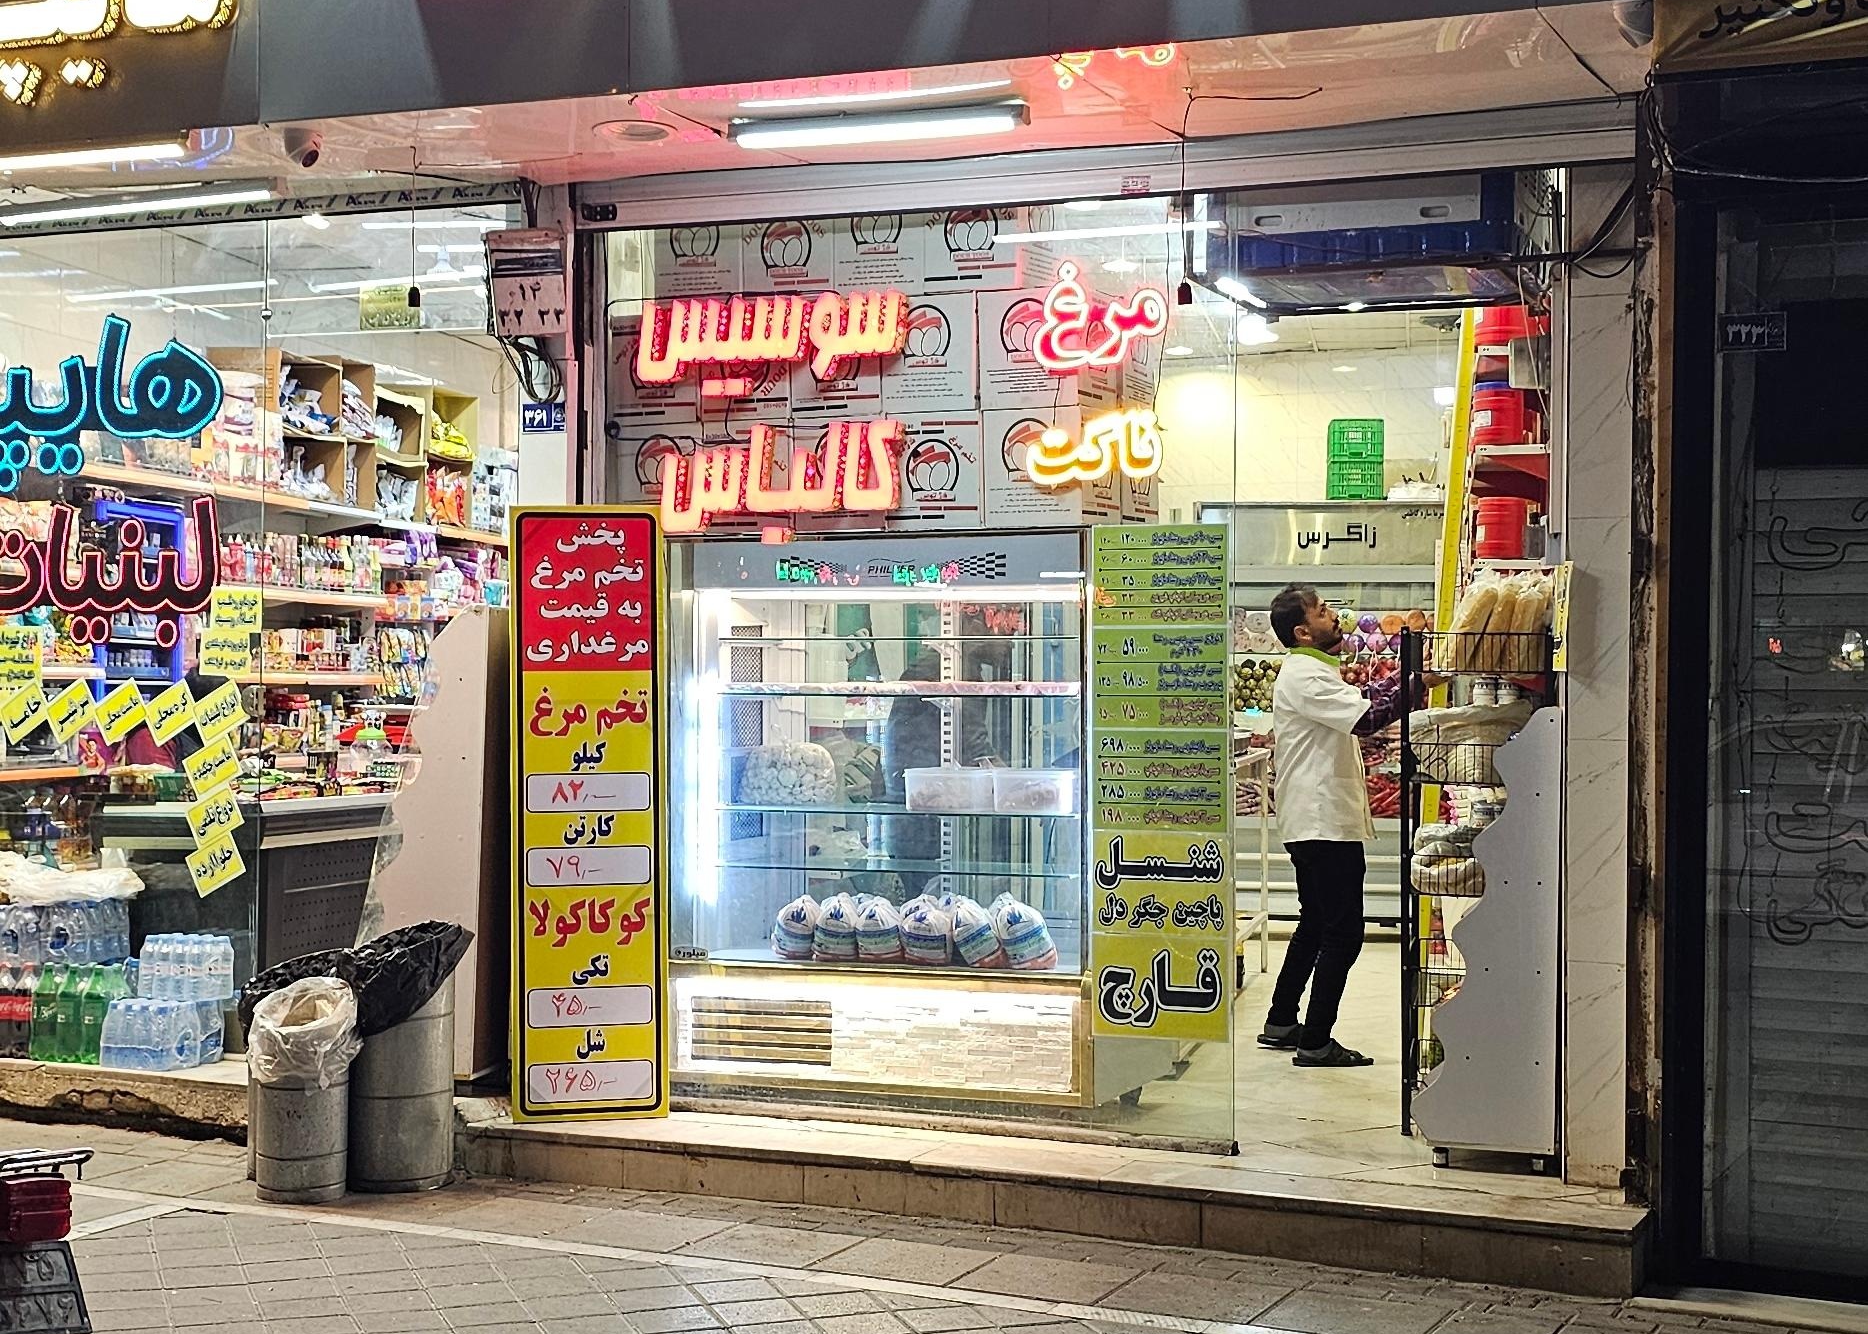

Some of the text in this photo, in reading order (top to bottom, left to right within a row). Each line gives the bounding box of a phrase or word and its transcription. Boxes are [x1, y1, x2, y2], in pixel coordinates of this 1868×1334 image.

[1033, 261, 1169, 370] مرغ
[637, 287, 909, 399] سوسیس
[524, 409, 547, 427] ۳۶۱
[661, 421, 905, 545] کالباس
[556, 522, 626, 554] پخش
[1297, 523, 1377, 550] زاگرس
[530, 555, 644, 589] تخم مرغ
[539, 592, 643, 624] به قیمت
[526, 630, 649, 662] مرغداری
[530, 686, 648, 736] تخم مرغ
[571, 741, 606, 771] کیلو
[563, 815, 614, 845] کارتن
[1095, 835, 1224, 889] شنسل
[528, 898, 650, 947] کوکاکولا
[1099, 892, 1224, 931] پاچین جگر دل
[572, 955, 609, 985] تکی
[1098, 949, 1223, 1027] قارچ
[576, 1029, 605, 1059] شل
